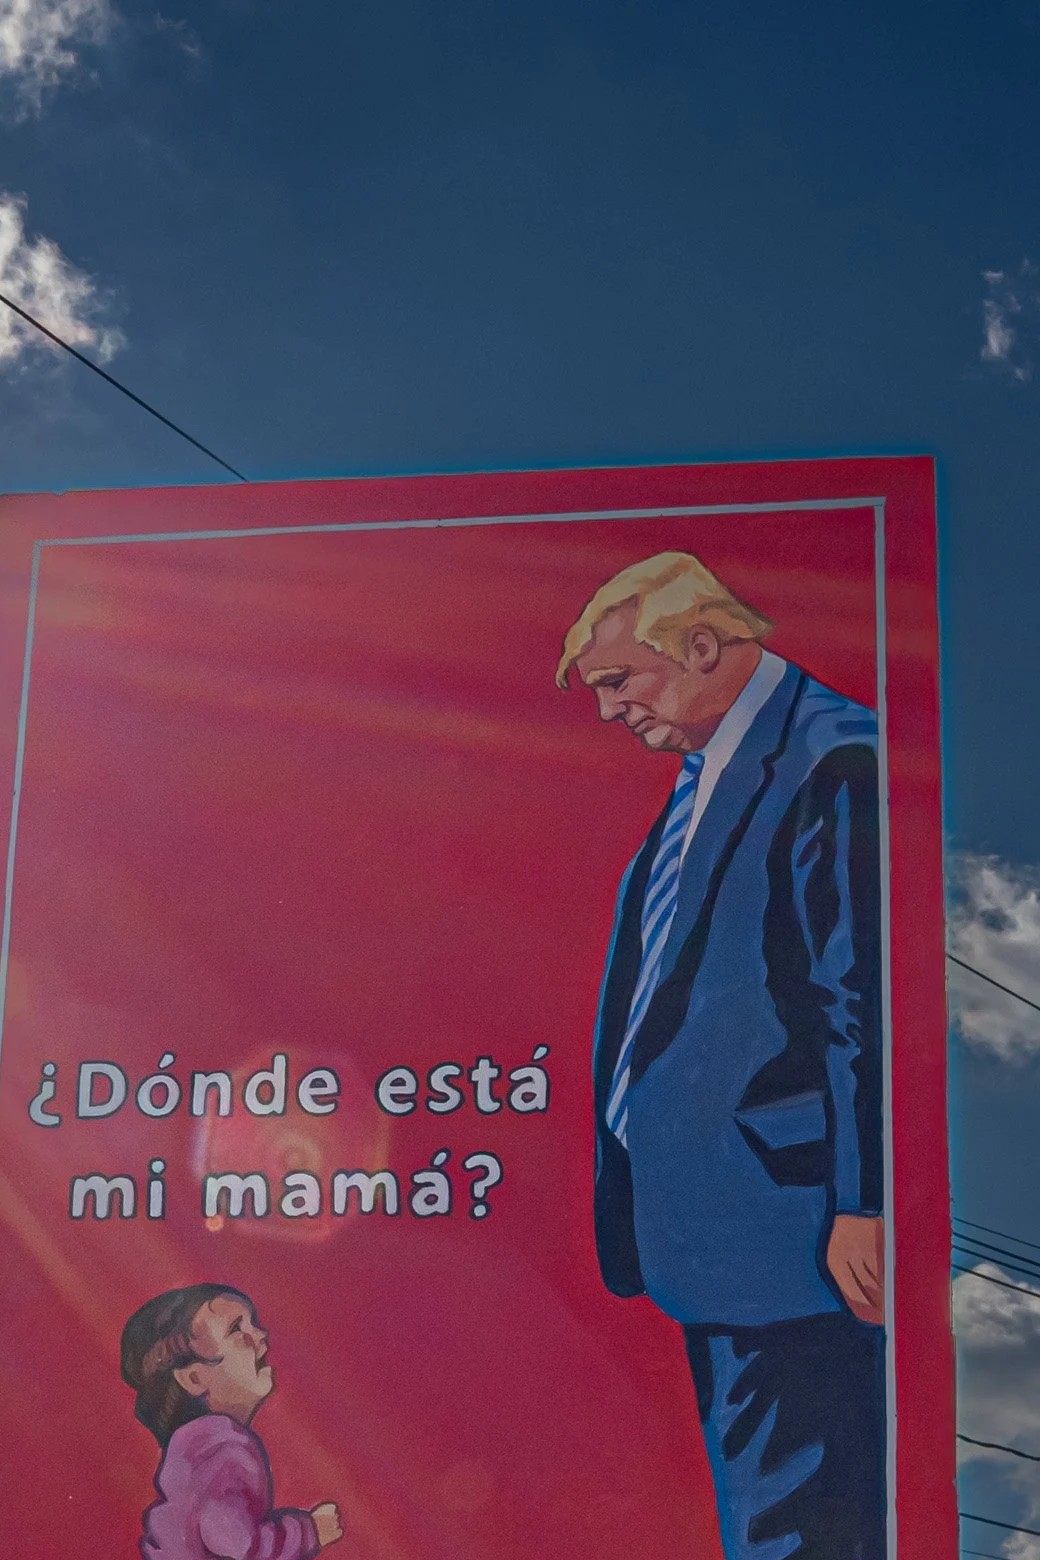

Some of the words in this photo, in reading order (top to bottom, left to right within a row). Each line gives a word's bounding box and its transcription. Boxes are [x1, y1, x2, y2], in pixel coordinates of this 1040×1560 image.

[27, 1050, 342, 1127] ¿Dónde
[375, 1043, 551, 1117] está
[69, 1157, 166, 1220] mi
[202, 1148, 503, 1222] mamá?
